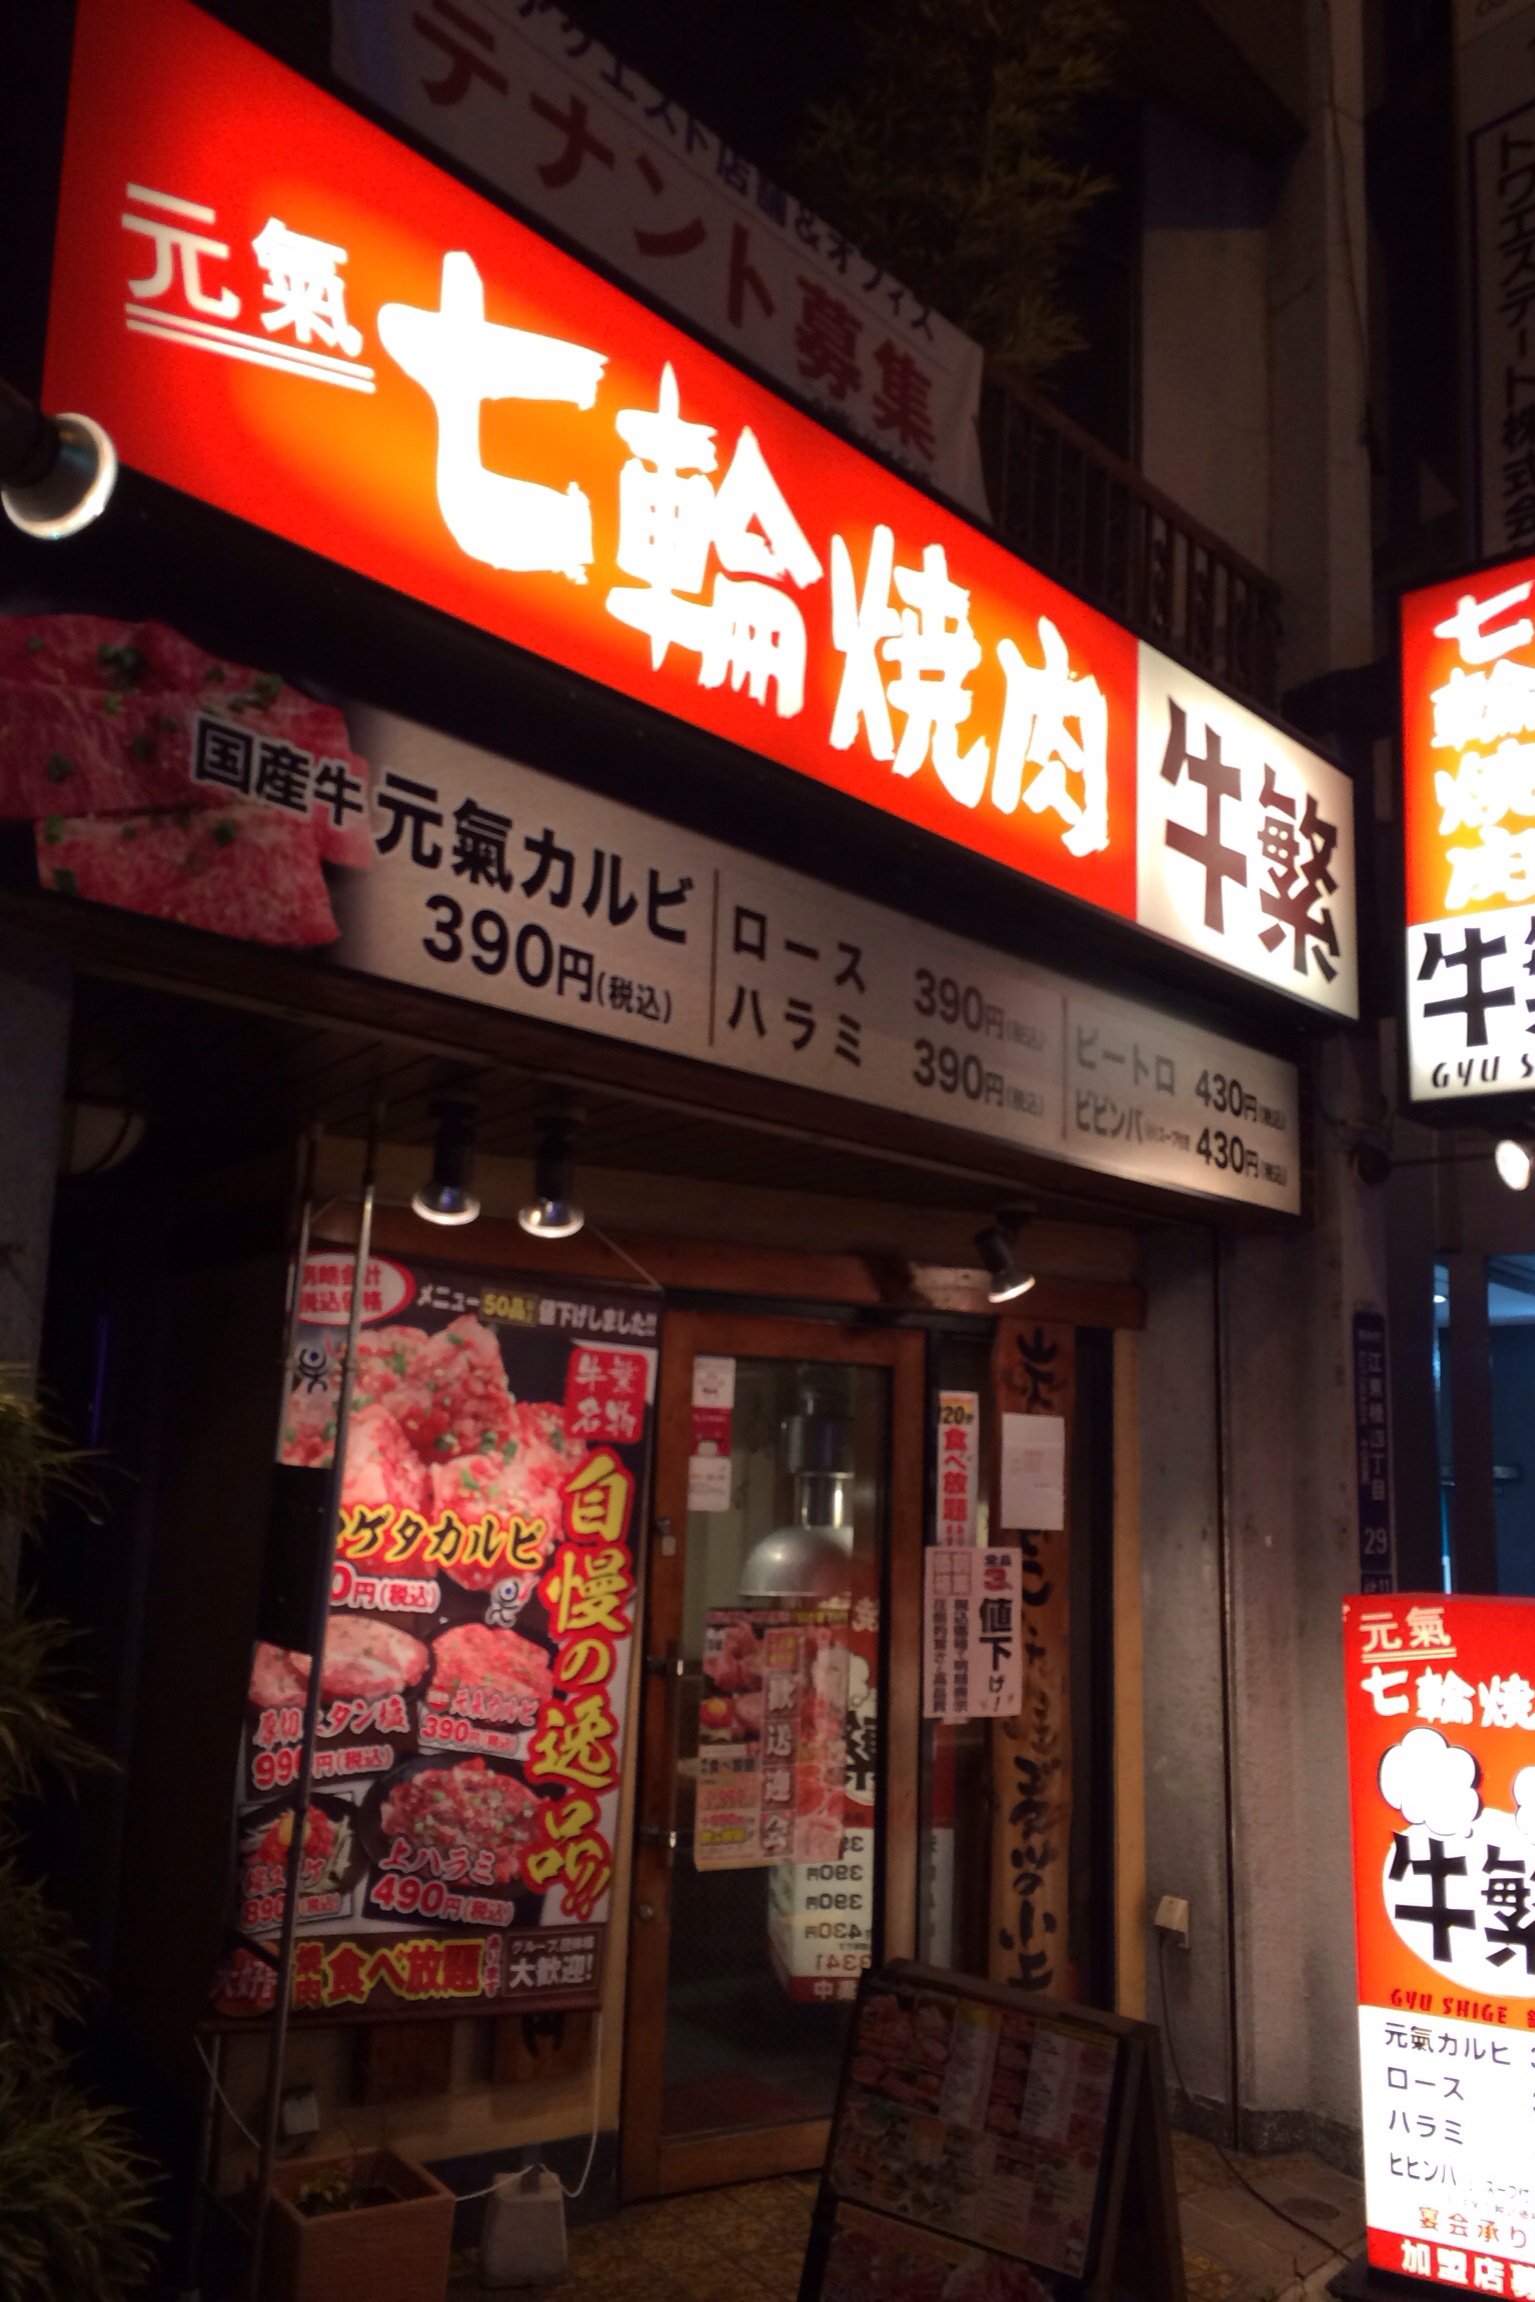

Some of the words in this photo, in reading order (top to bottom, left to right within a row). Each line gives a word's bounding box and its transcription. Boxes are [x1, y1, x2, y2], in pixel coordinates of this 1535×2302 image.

[411, 0, 934, 463] テナント募集
[377, 250, 1109, 858] 七輪焼肉
[194, 718, 362, 825] 国産牛
[1161, 694, 1341, 984] 牛繁
[732, 906, 868, 995] ロース
[1417, 916, 1535, 1048] 牛
[727, 984, 863, 1068] ハラミ
[1431, 1055, 1501, 1089] GYU
[1364, 1527, 1388, 1555] 29
[1360, 1607, 1453, 1652] 元氣
[378, 1838, 496, 1886] 上ハラミ
[1391, 1988, 1432, 2011] GYU
[1442, 1997, 1508, 2025] SHIGE
[1387, 2066, 1465, 2101] ロース
[1388, 2109, 1464, 2145] ハラミ
